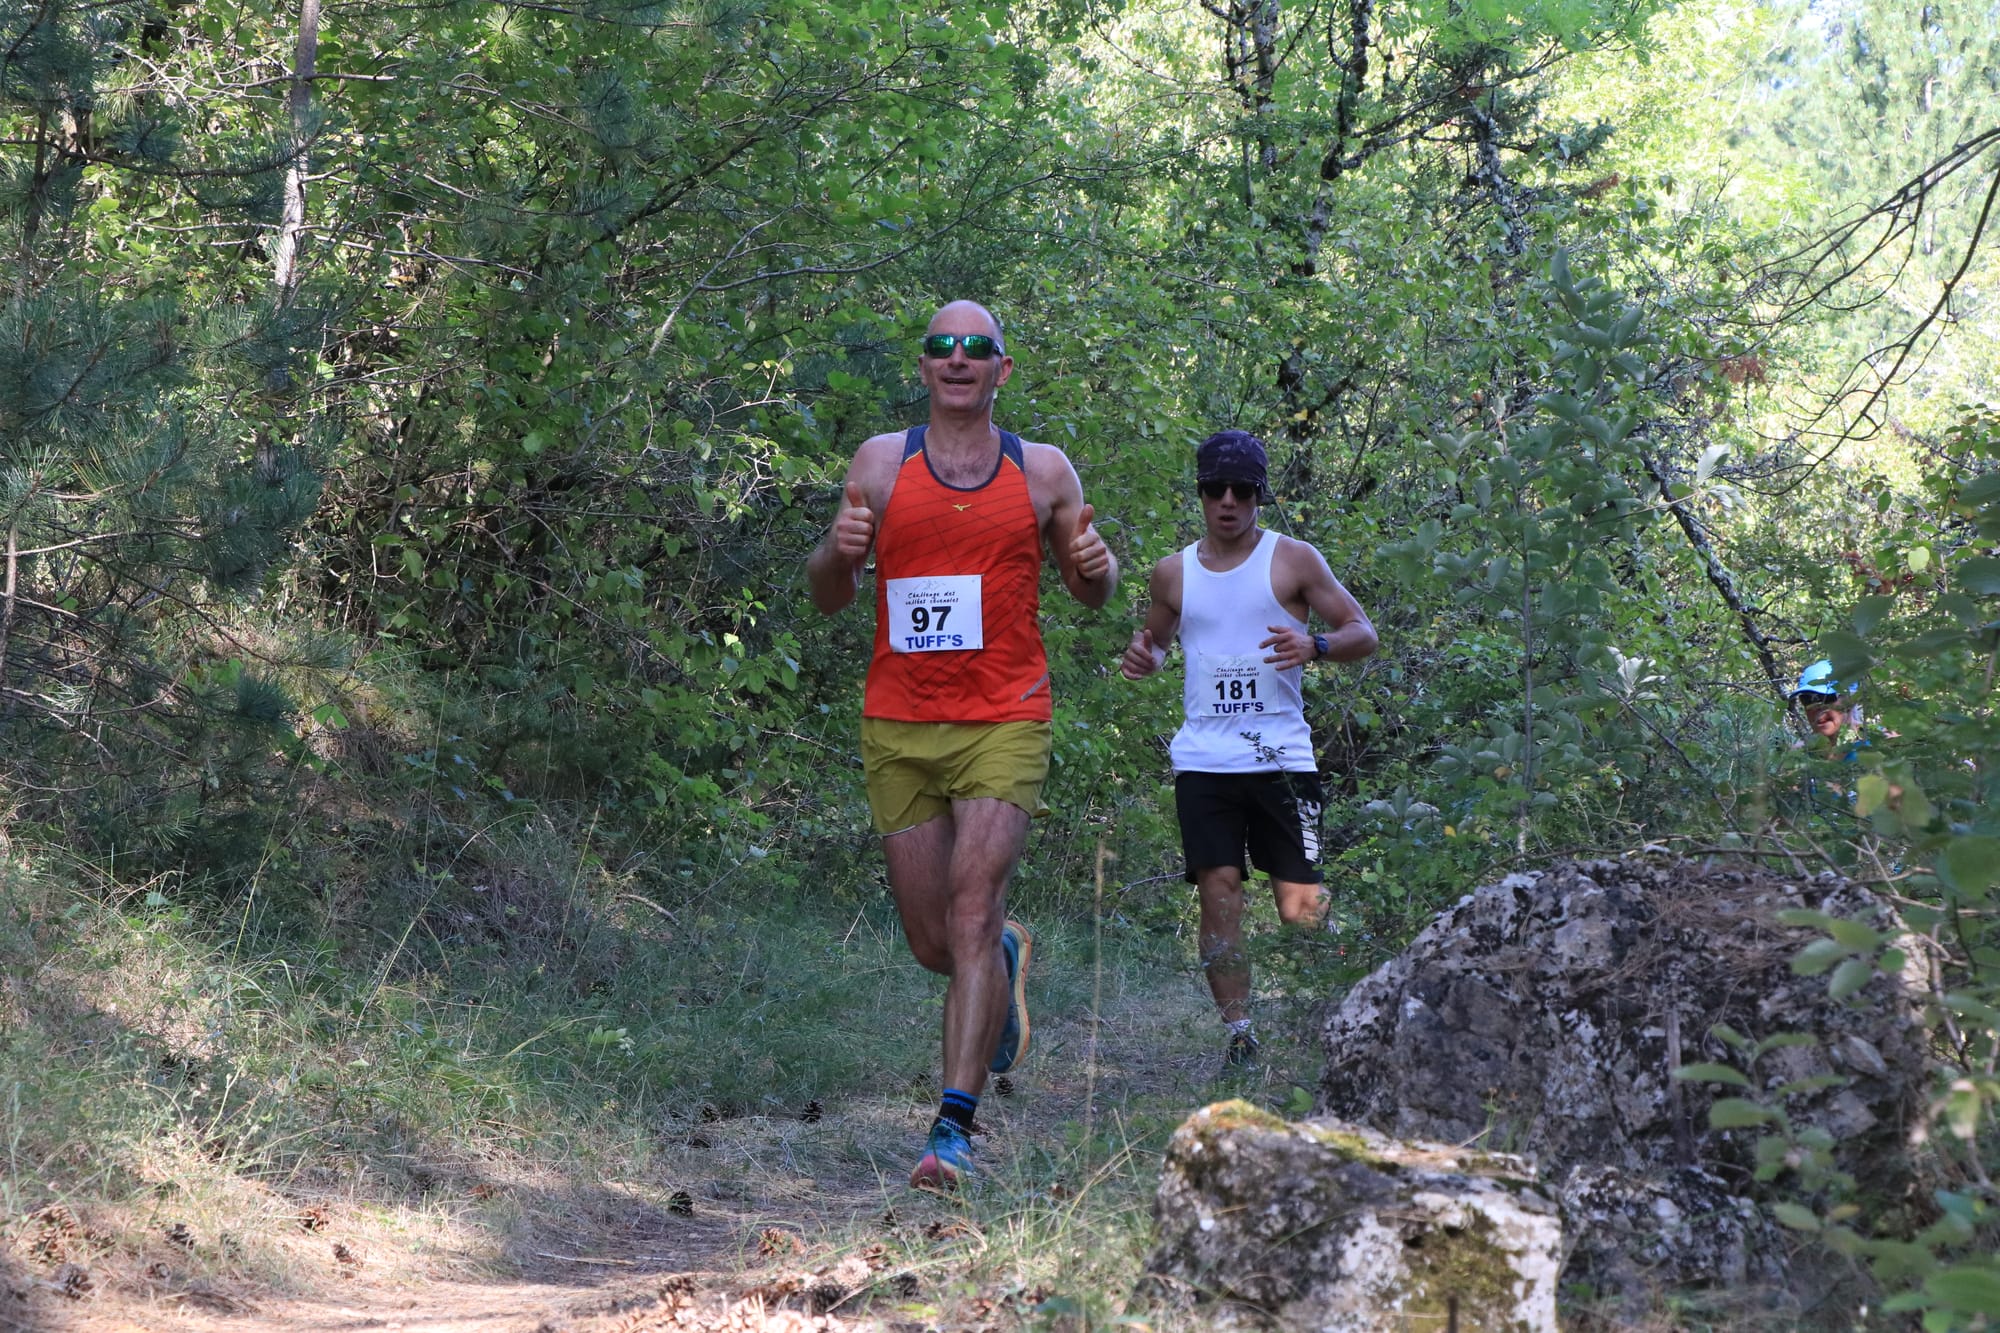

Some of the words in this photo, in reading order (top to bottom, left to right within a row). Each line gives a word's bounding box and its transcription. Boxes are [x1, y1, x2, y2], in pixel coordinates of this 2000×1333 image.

[908, 591, 940, 599] Challenge
[912, 606, 952, 633] 97
[905, 634, 963, 649] TUFF'S
[1215, 679, 1257, 700] 181
[1213, 701, 1264, 714] TUFF'S
